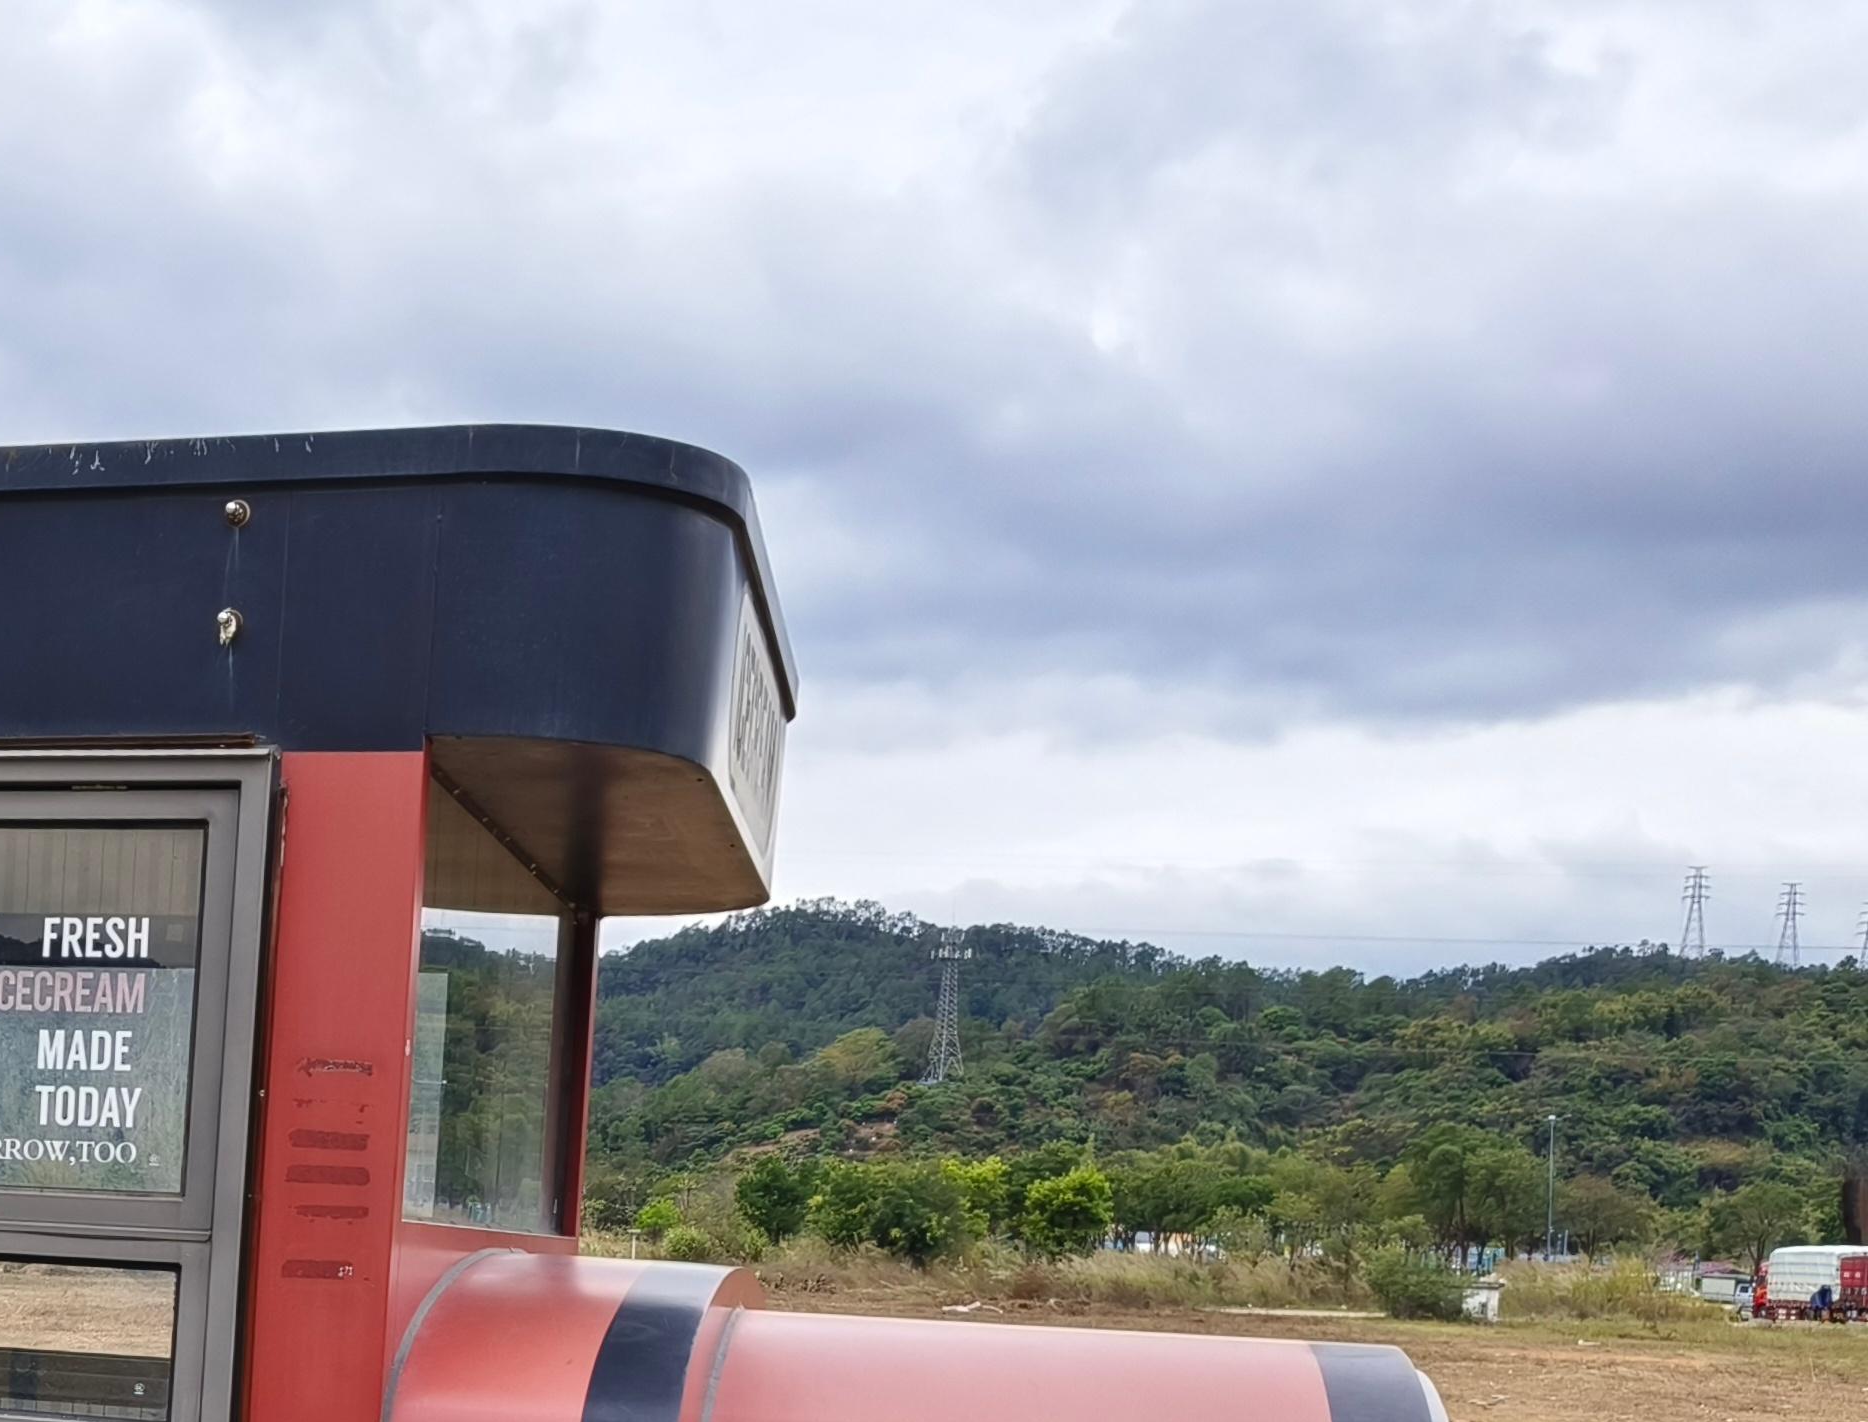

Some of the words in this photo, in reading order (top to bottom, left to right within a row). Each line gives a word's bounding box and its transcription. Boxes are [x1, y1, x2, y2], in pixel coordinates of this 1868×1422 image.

[42, 917, 150, 958] FRESH
[36, 1029, 133, 1072] MADE
[35, 1085, 142, 1128] TODAY
